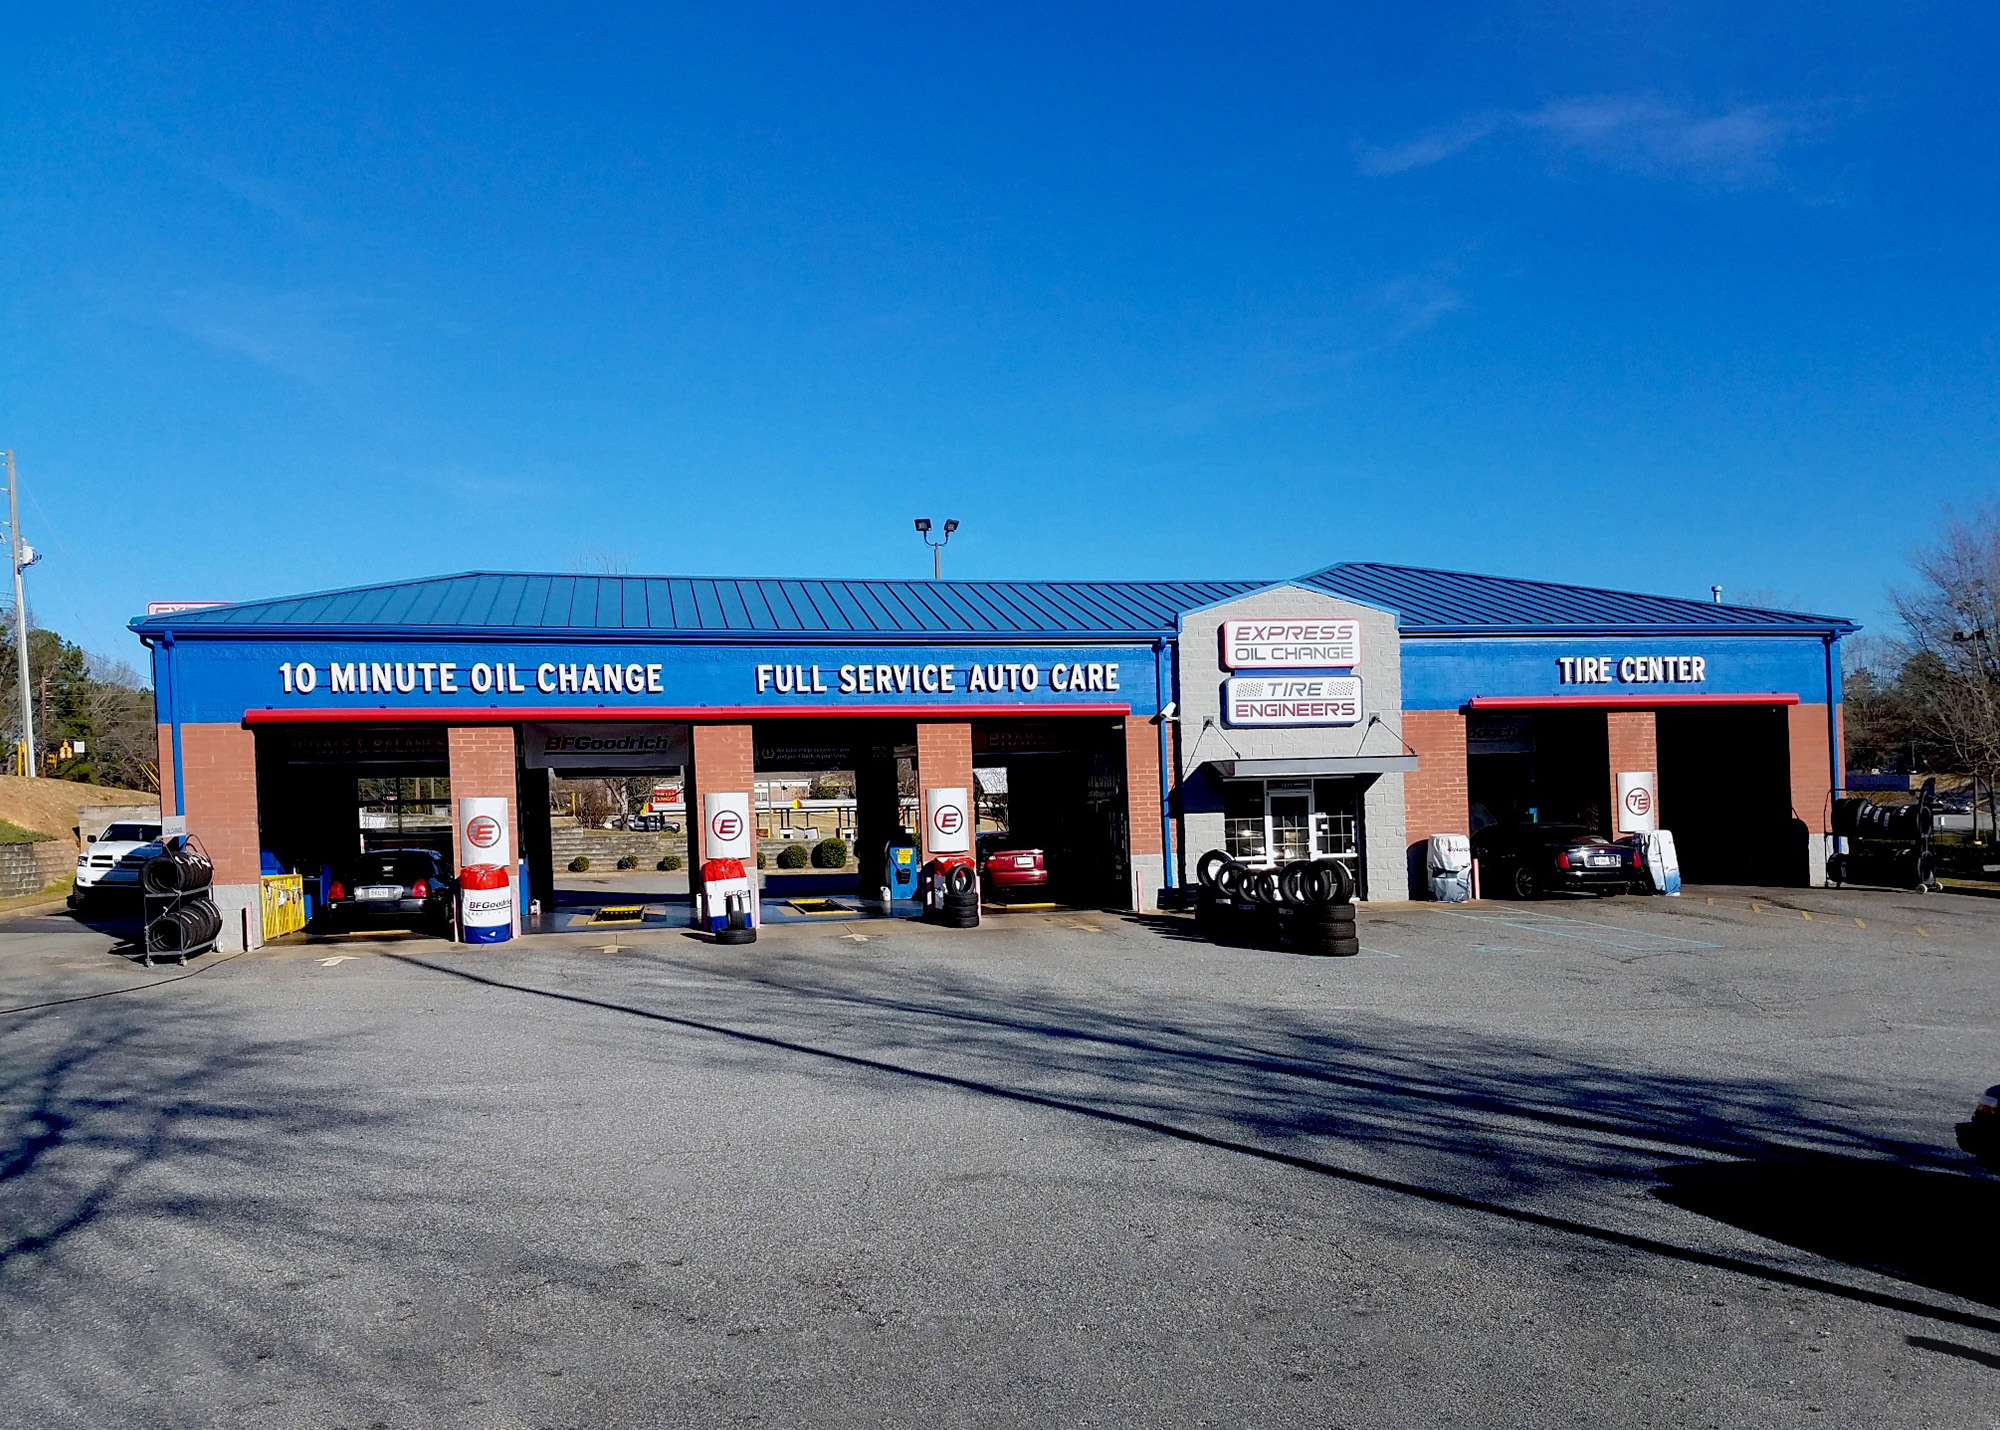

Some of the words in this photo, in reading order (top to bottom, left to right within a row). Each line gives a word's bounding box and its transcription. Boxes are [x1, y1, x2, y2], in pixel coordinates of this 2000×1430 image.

[1235, 626, 1354, 641] EXPRESS
[1235, 647, 1266, 661] OIL
[1271, 646, 1354, 660] CHANGE
[279, 662, 317, 693] 10
[330, 662, 458, 693] MINUTE
[471, 662, 525, 693] OIL
[537, 662, 664, 692] CHANGE
[757, 663, 828, 693] FULL
[840, 663, 956, 692] SERVICE
[969, 663, 1039, 691] AUTO
[1052, 662, 1120, 691] CARE
[1559, 656, 1613, 684] TIRE
[1621, 656, 1706, 683] CENTER
[1268, 682, 1324, 697] TIRE
[1235, 702, 1356, 718] ENGINEERS
[545, 735, 668, 751] BFGoodrich
